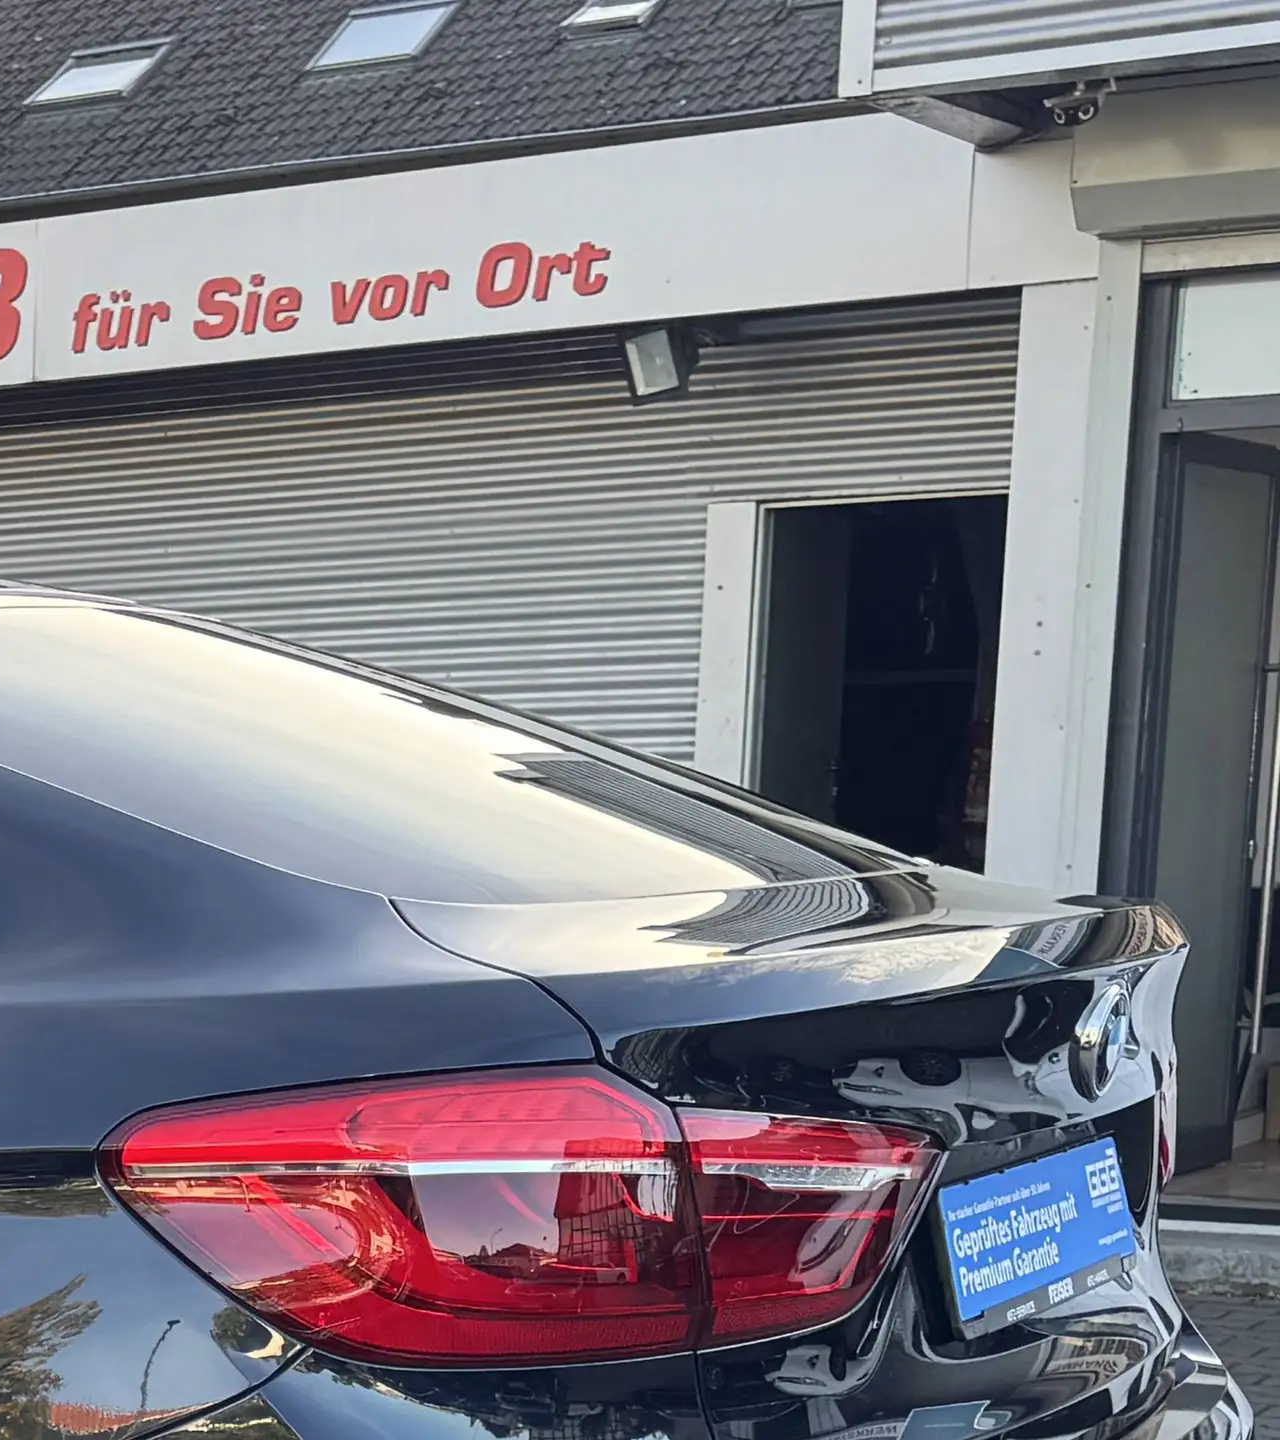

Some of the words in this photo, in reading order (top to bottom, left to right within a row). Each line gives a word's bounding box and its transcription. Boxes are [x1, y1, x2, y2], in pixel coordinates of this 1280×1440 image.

[72, 290, 170, 353] für
[193, 273, 301, 339] Sie
[331, 269, 448, 324] vor
[476, 241, 609, 308] Ort
[953, 1216, 1012, 1263] Geprüftes
[1010, 1205, 1061, 1239] Fahrzeug
[1059, 1191, 1078, 1223] mit
[959, 1256, 1014, 1297] Premium
[1013, 1236, 1060, 1277] Garantie
